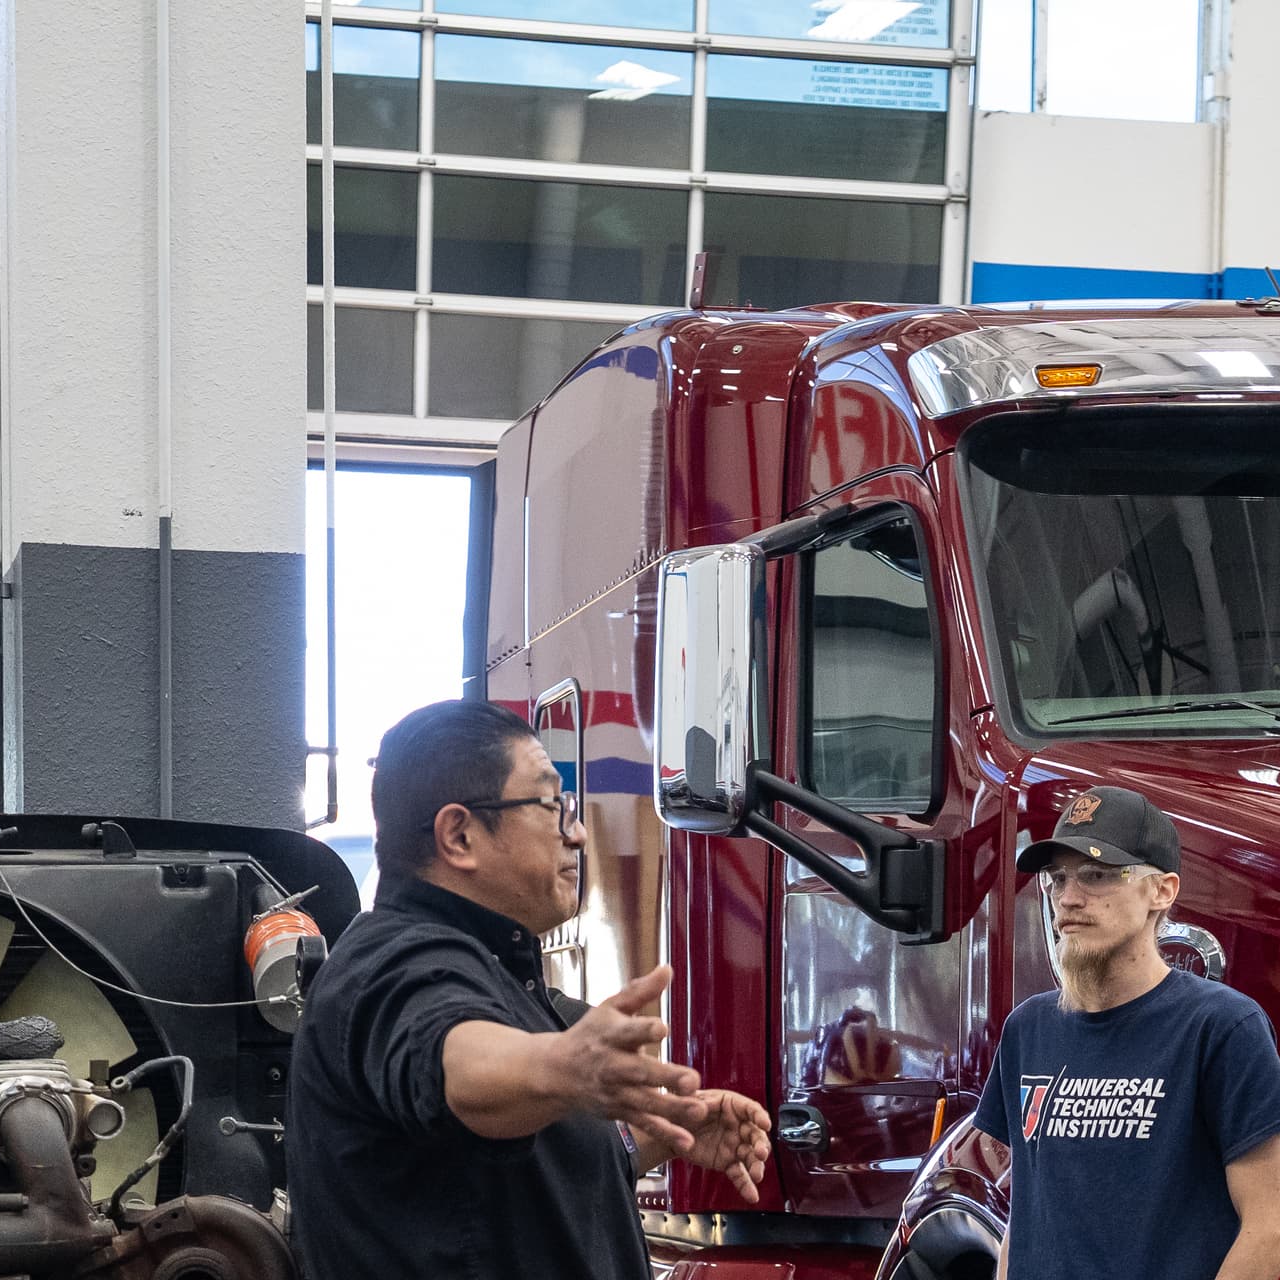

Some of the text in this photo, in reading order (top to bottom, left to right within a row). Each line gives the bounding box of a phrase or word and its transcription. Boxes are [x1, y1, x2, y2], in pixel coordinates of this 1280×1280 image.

[1058, 1078, 1166, 1098] UNIVERSAL
[1051, 1098, 1158, 1118] TECHNICAL
[1046, 1118, 1154, 1139] INSTITUTE
